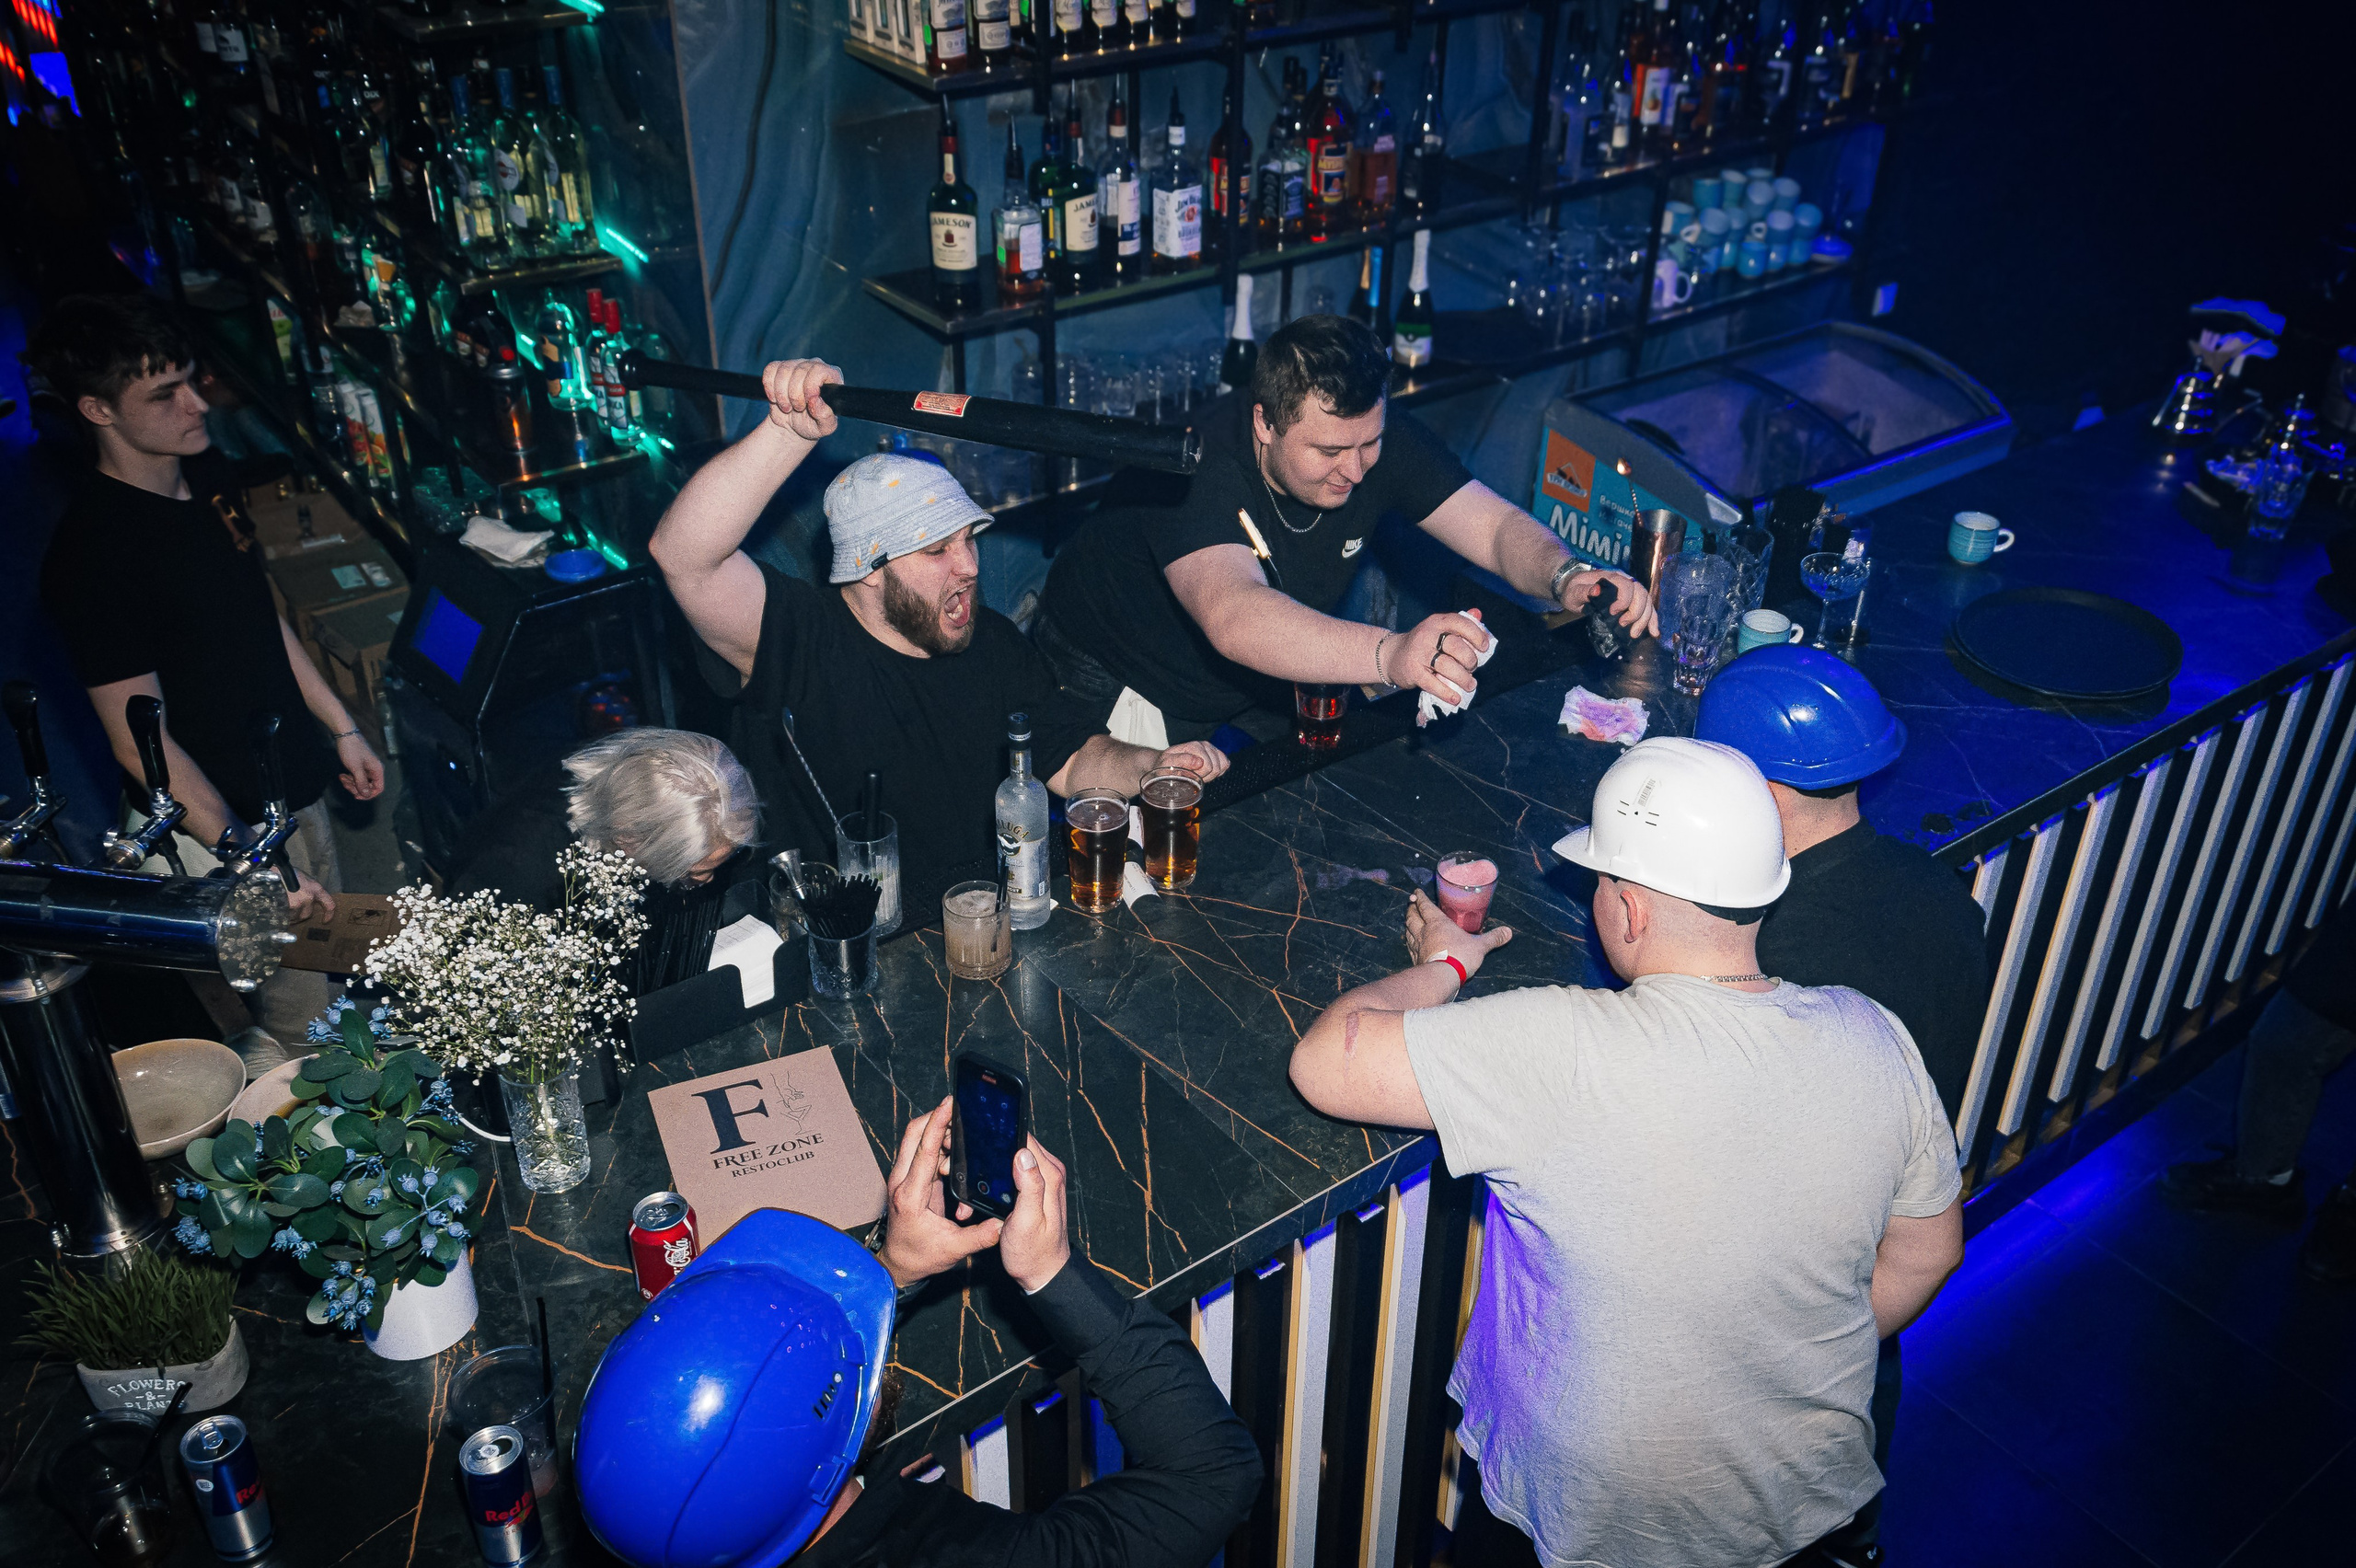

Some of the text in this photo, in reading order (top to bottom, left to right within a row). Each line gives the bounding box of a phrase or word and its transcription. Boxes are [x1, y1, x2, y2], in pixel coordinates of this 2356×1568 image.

[931, 215, 972, 229] JAMESON
[1600, 494, 1636, 518] Вершко
[1345, 537, 1363, 550] NIKE
[996, 818, 1029, 838] LUGA
[690, 1078, 769, 1155] F
[712, 1133, 825, 1170] FREE ZONE
[731, 1150, 815, 1178] RESTOCLUB
[485, 1500, 522, 1522] Red
